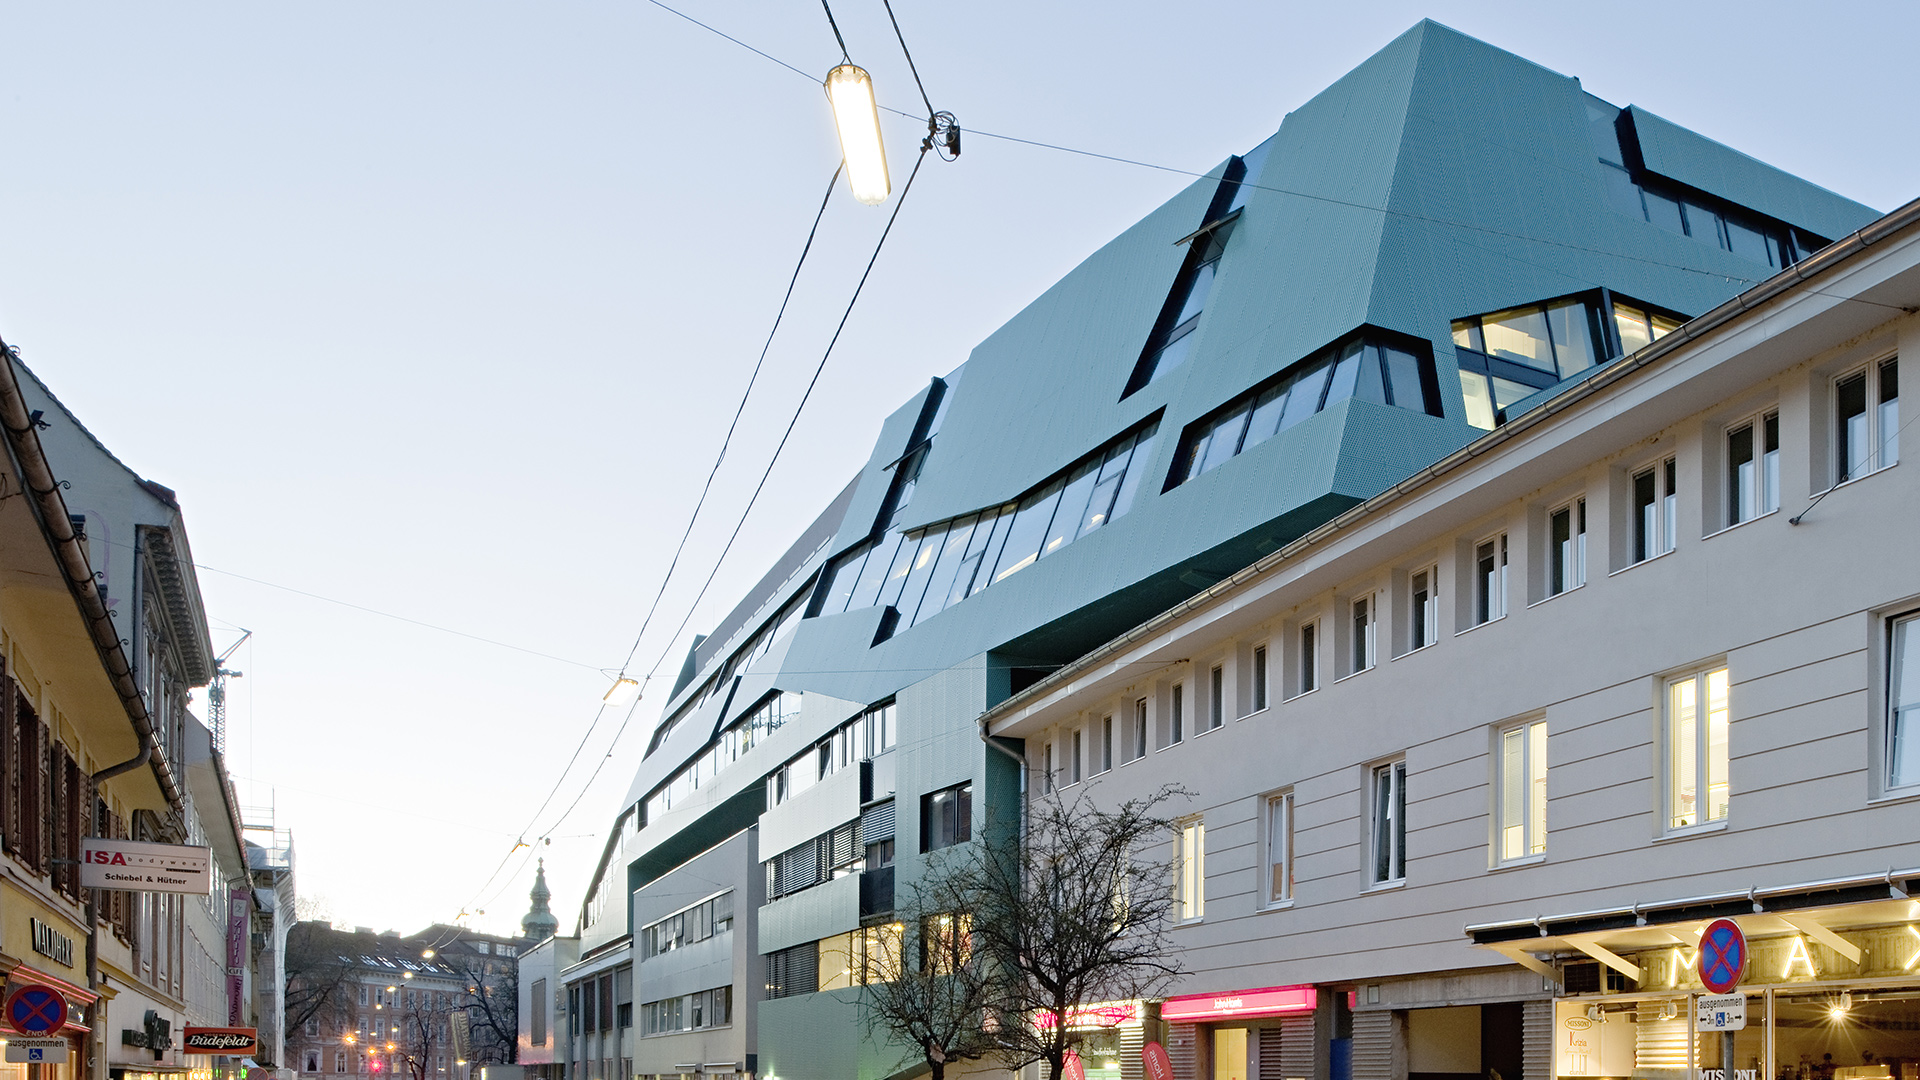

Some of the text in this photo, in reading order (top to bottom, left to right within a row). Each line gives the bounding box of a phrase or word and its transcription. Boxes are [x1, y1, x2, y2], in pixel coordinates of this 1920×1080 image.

[85, 850, 206, 867] ISA bodywear
[105, 873, 142, 882] Schiebel
[157, 876, 187, 885] Hütner
[31, 918, 74, 968] WALDHERR
[1700, 998, 1743, 1011] ausgenommen
[1707, 1012, 1735, 1025] 3m 3m
[8, 1040, 65, 1049] ausgenommen
[1569, 1031, 1588, 1047] Krizia
[1698, 1069, 1757, 1080] MISONI
